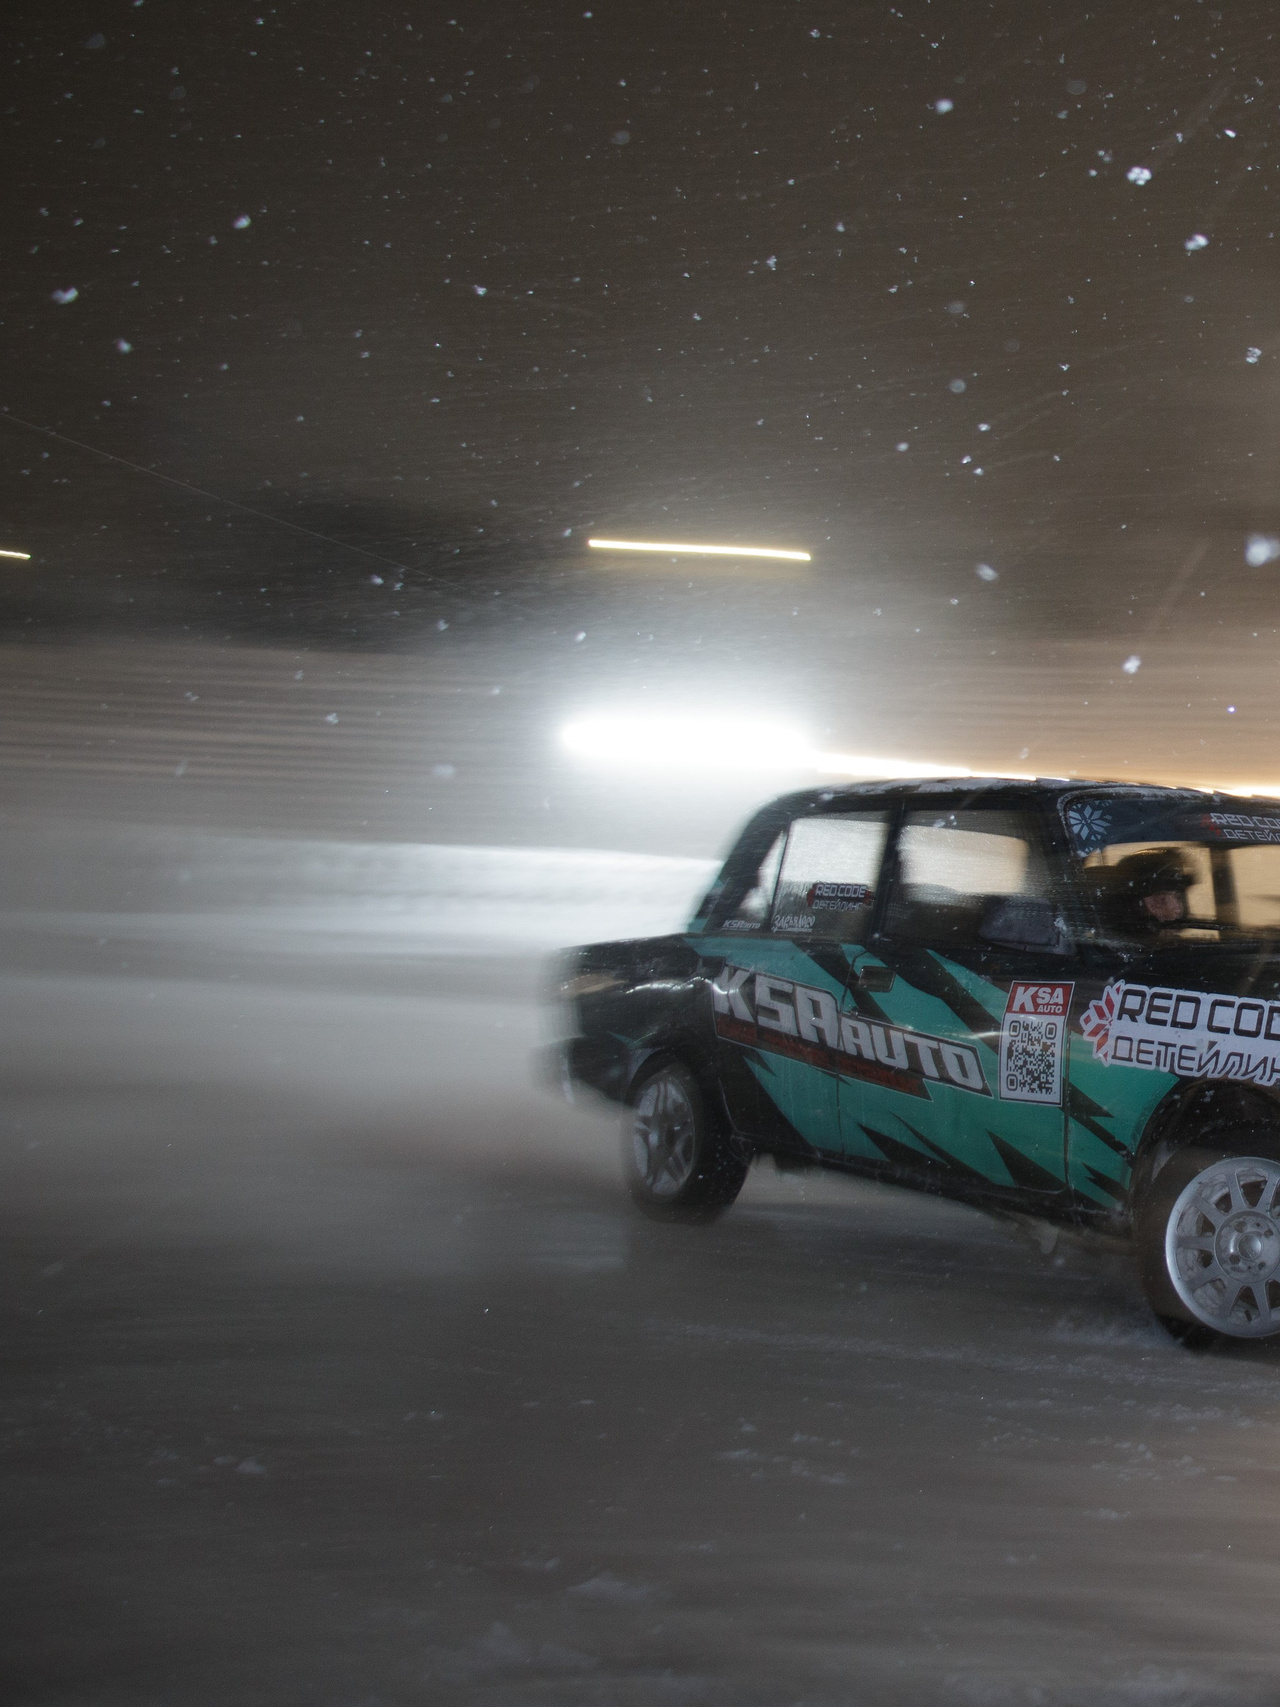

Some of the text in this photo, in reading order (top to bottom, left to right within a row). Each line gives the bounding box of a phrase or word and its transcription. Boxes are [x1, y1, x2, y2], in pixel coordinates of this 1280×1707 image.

[1210, 812, 1254, 827] RED
[815, 884, 867, 898] RED CODE
[1012, 986, 1064, 1012] KSA
[1036, 1004, 1063, 1013] AUTO
[1117, 988, 1201, 1031] RED
